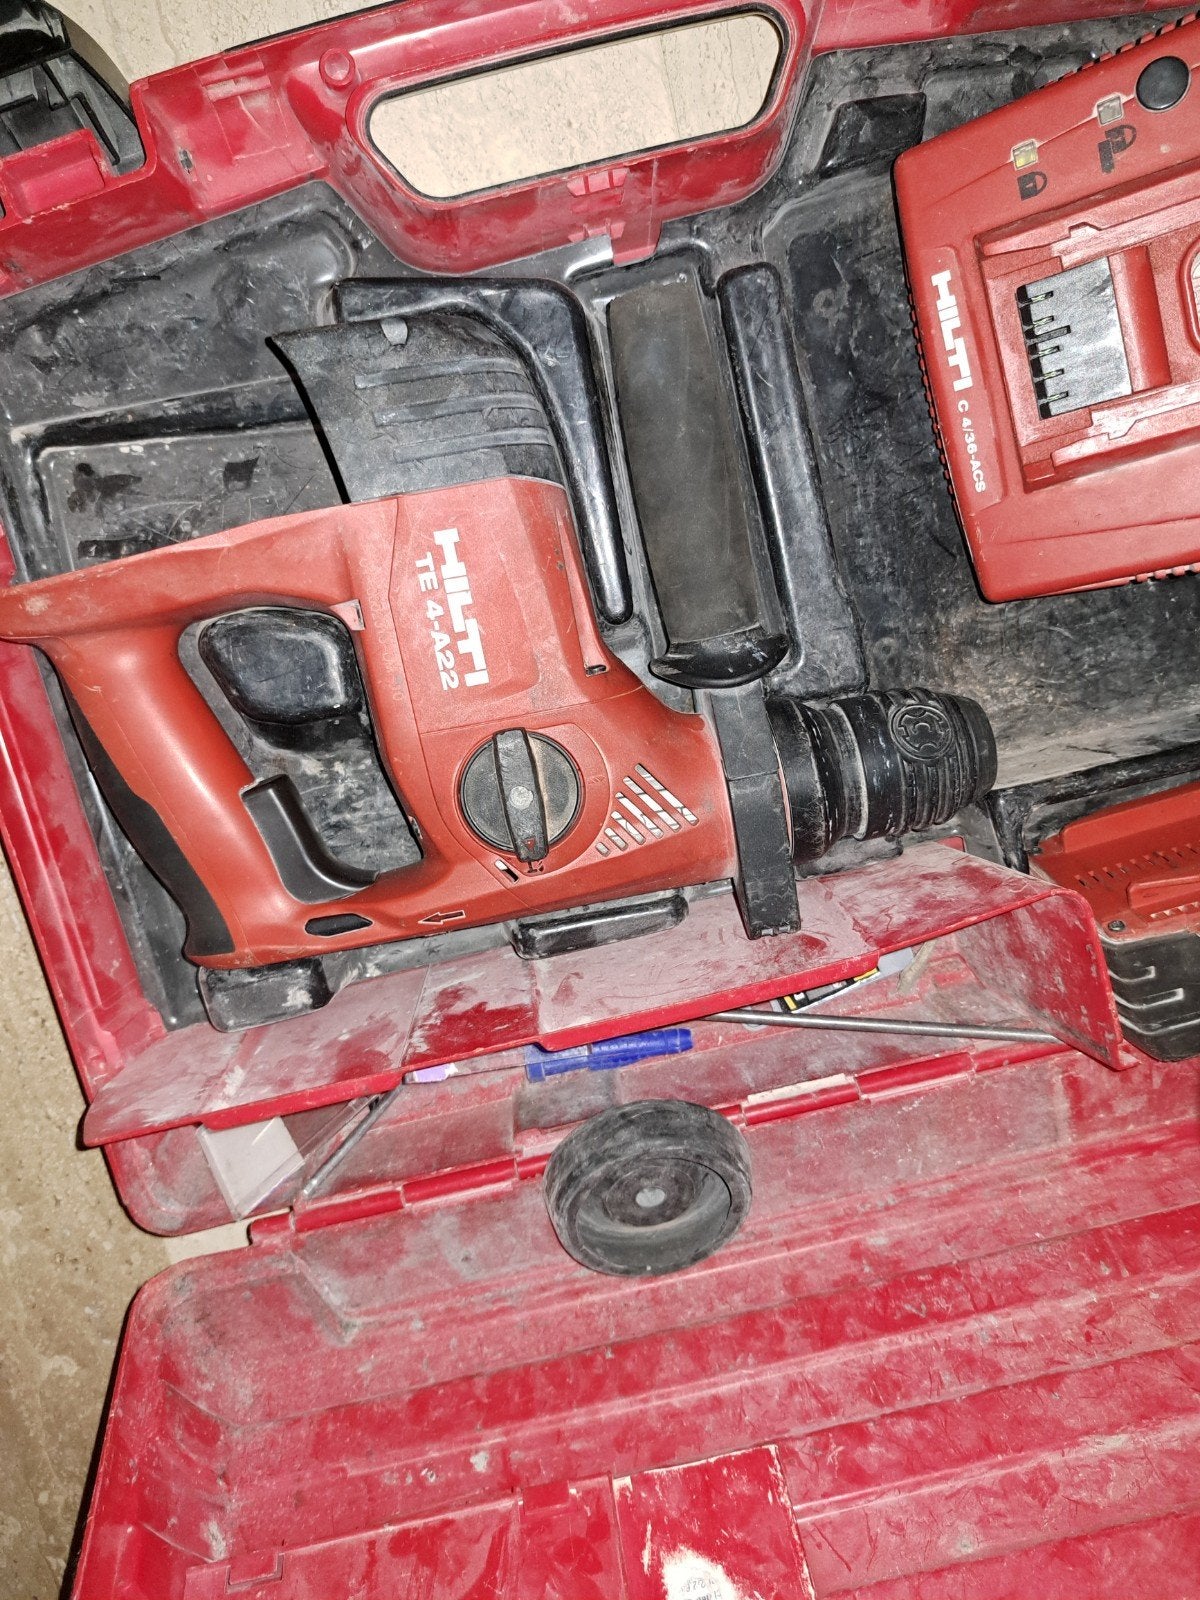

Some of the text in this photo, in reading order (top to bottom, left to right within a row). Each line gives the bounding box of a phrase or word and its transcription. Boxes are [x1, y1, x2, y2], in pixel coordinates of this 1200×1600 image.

[931, 269, 986, 493] HILTI C 4/36-ACS
[415, 551, 460, 691] TE 4-A22
[433, 527, 489, 687] HILTI
